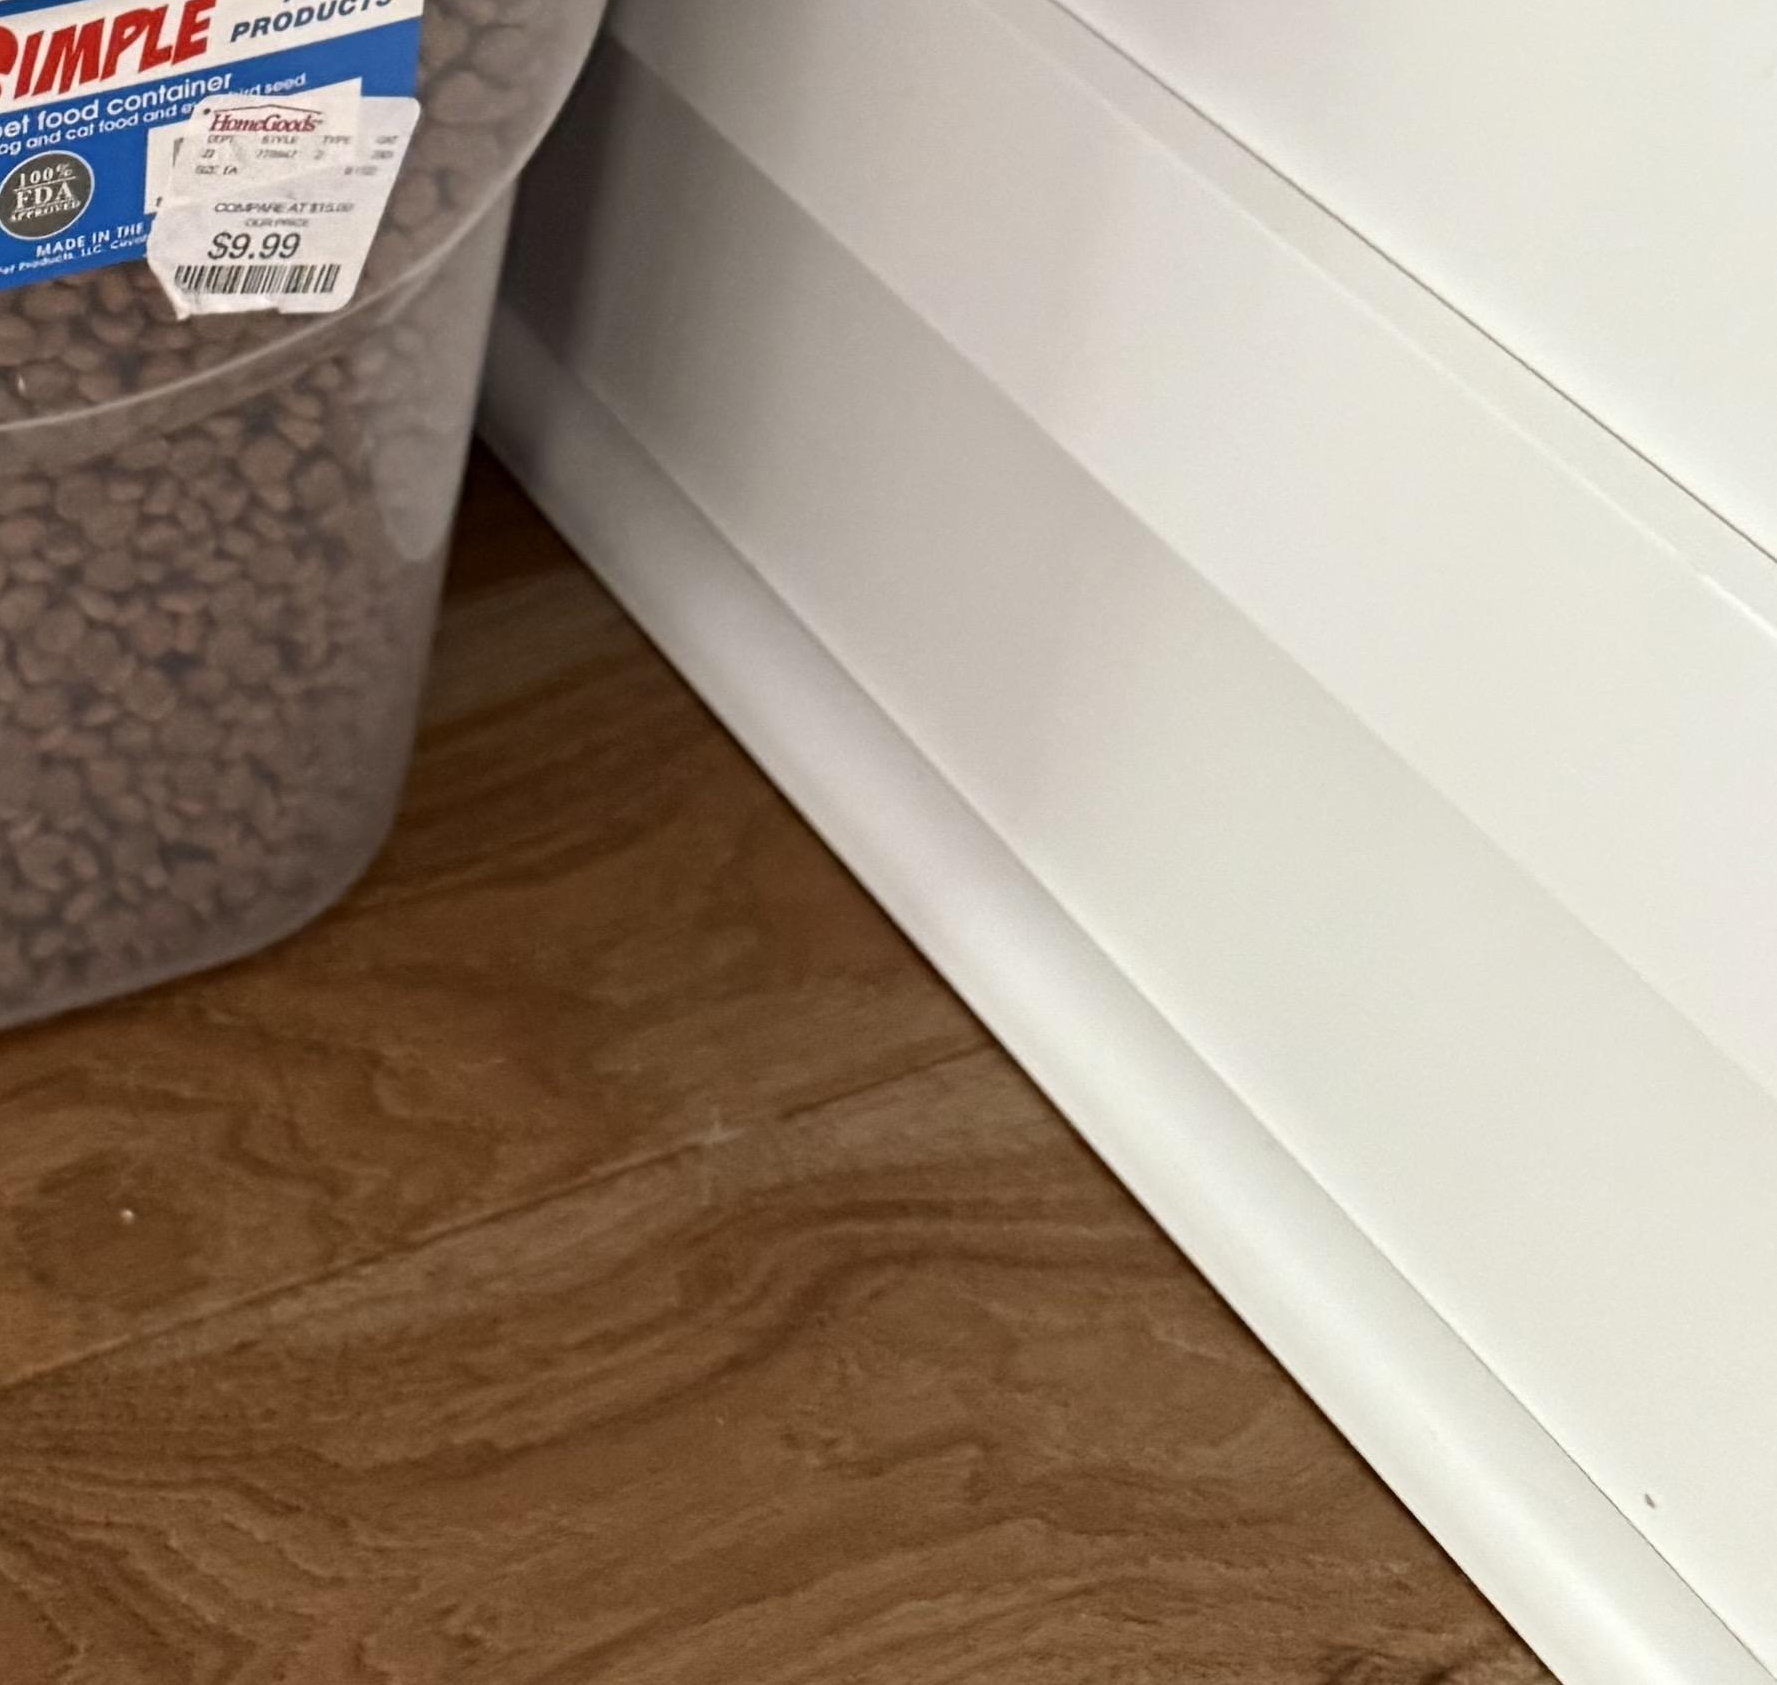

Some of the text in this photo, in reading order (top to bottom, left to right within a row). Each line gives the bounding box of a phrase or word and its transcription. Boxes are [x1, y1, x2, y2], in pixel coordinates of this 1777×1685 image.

[26, 129, 61, 147] and
[65, 122, 94, 140] cat
[99, 112, 139, 133] food
[143, 103, 177, 122] and
[264, 72, 306, 94] seed
[38, 99, 99, 129] food
[107, 73, 232, 116] container
[209, 113, 317, 132] HomeGoods
[19, 163, 73, 188] 100%
[16, 181, 74, 210] FDA
[214, 202, 283, 213] COMPARE
[288, 202, 307, 213] AT
[10, 199, 82, 223] APPROVED
[36, 234, 85, 258] MADE
[92, 229, 110, 244] IN
[116, 221, 144, 239] THE
[207, 231, 301, 260] $9.99
